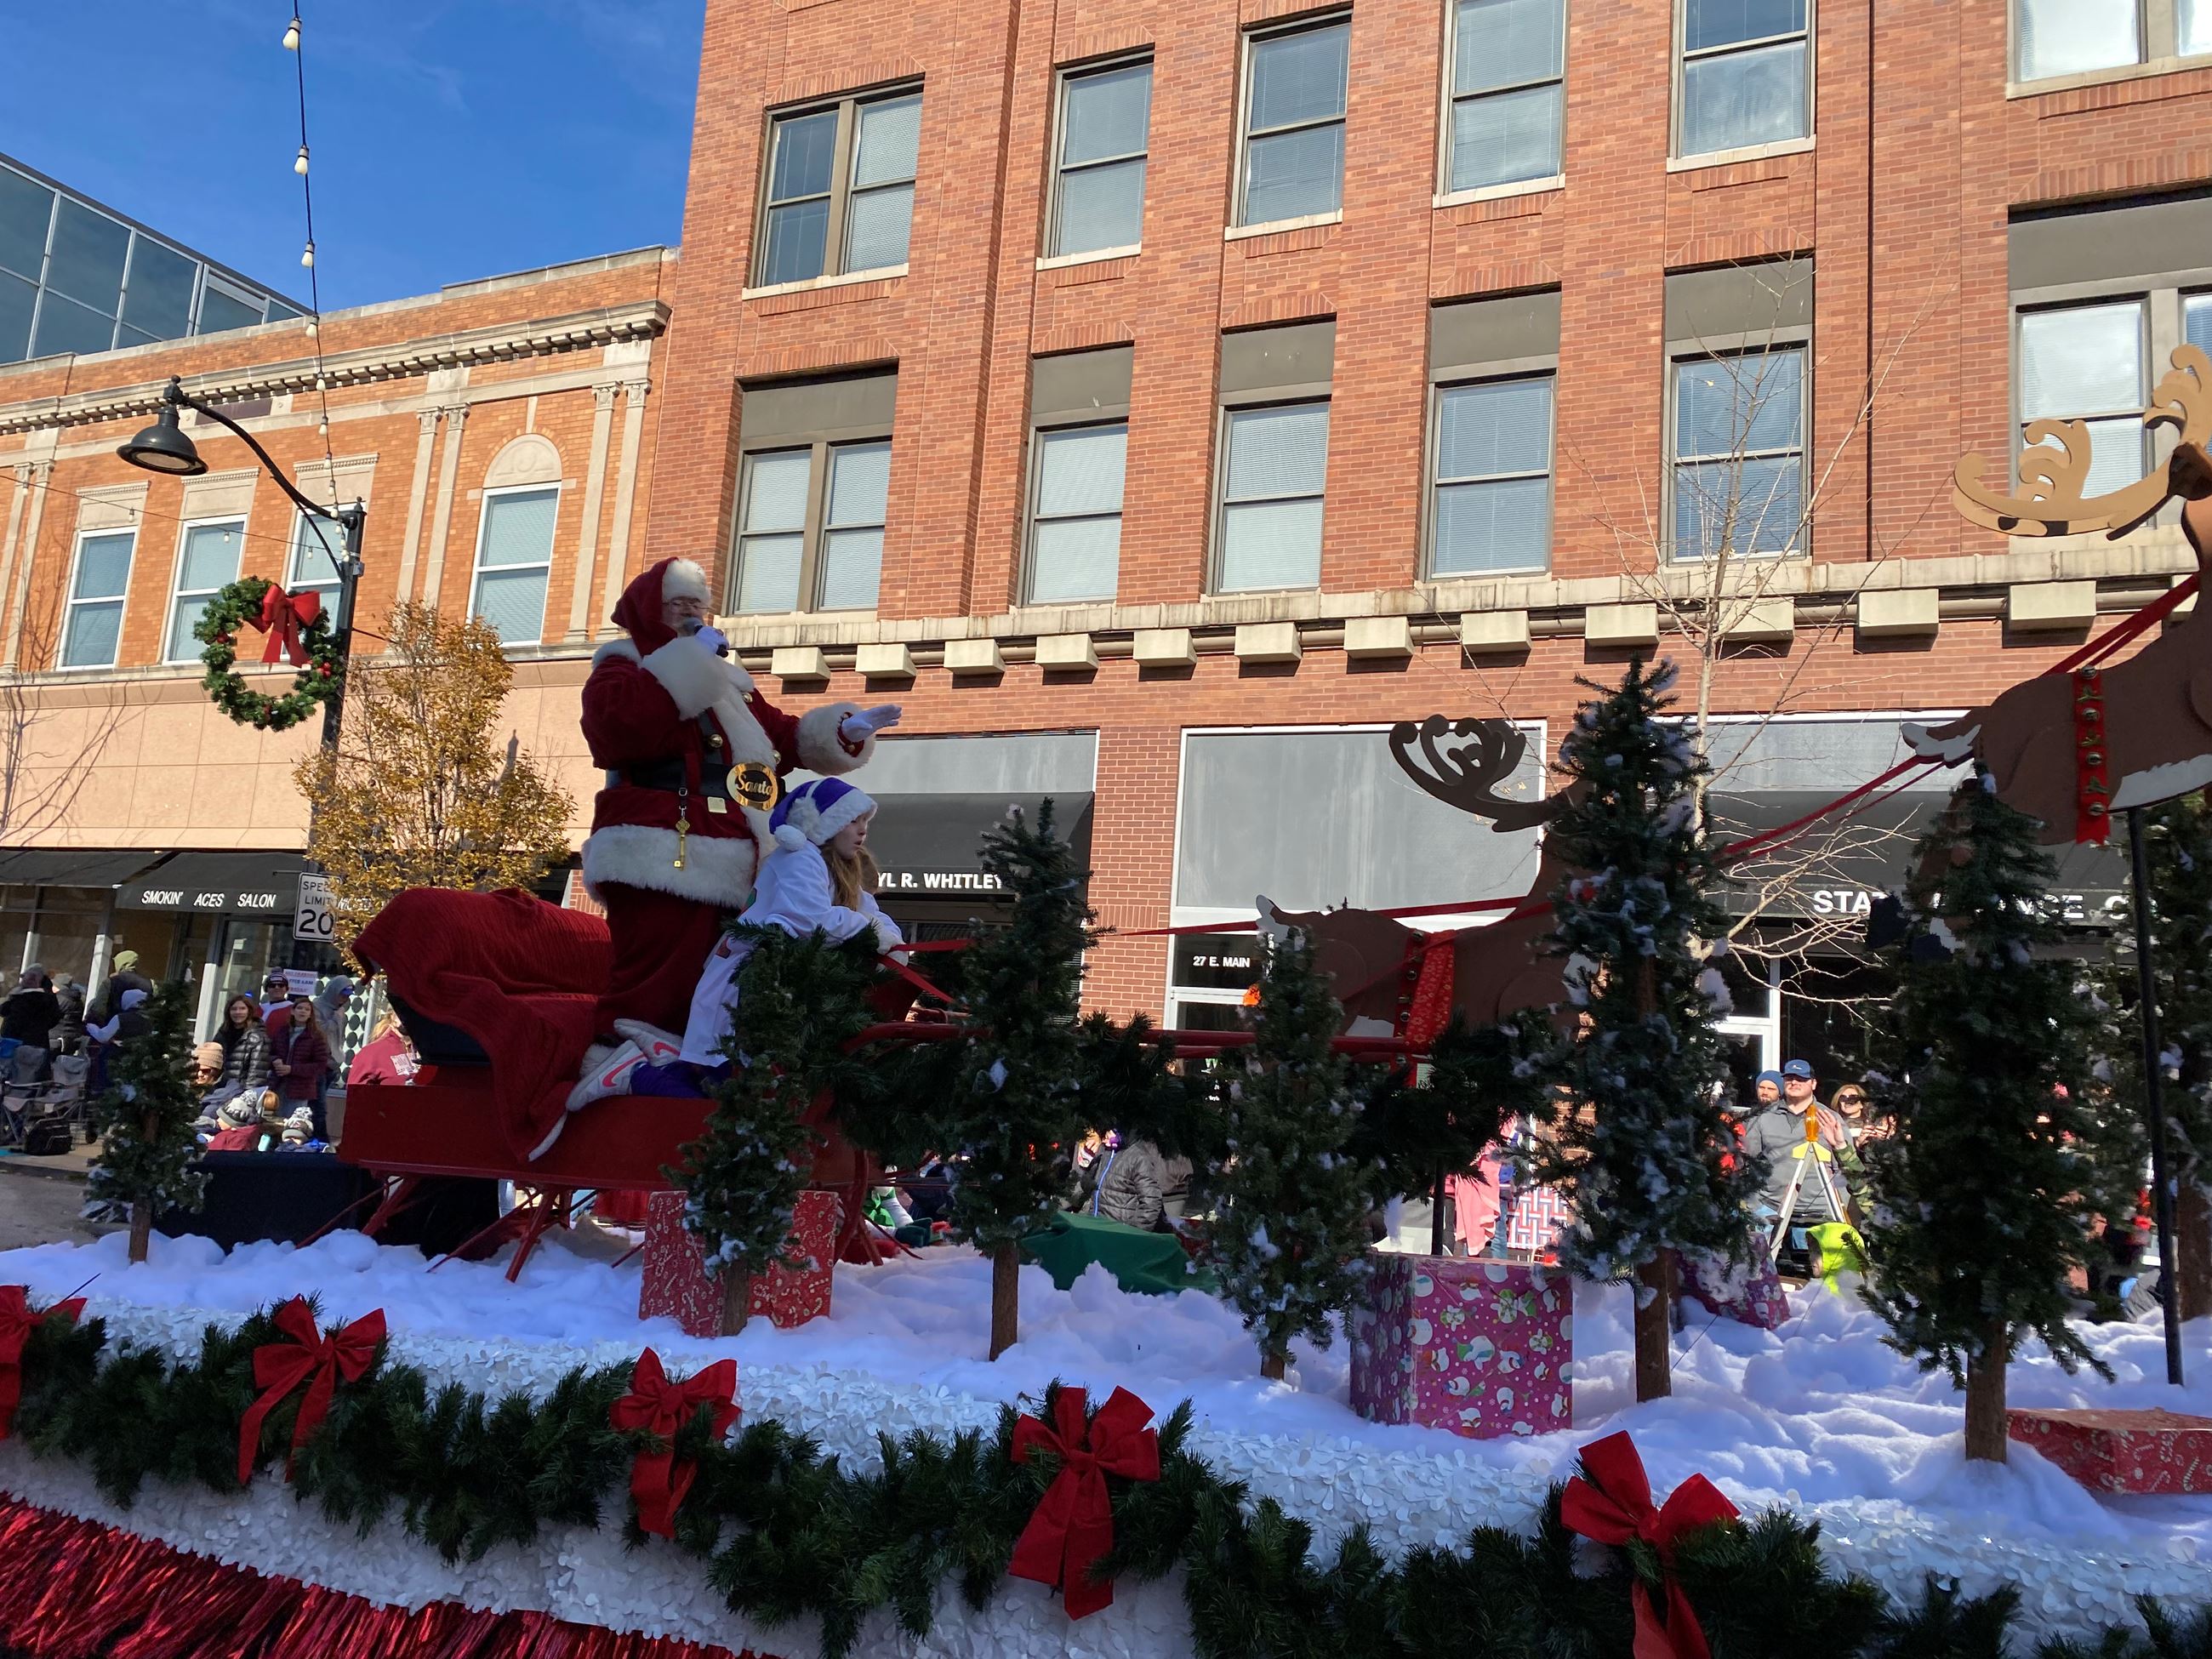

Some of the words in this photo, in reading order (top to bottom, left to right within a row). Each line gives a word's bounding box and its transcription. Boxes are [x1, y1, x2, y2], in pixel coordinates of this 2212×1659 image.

[736, 773, 773, 795] Santa
[302, 881, 330, 892] SPEE
[901, 872, 918, 887] R.
[141, 890, 184, 905] SMOKIN'
[193, 892, 225, 907] ACES
[237, 892, 276, 908] SALON
[299, 909, 334, 935] 20
[1193, 955, 1206, 966] 27
[1209, 956, 1219, 967] E.
[1223, 957, 1250, 968] MAIN
